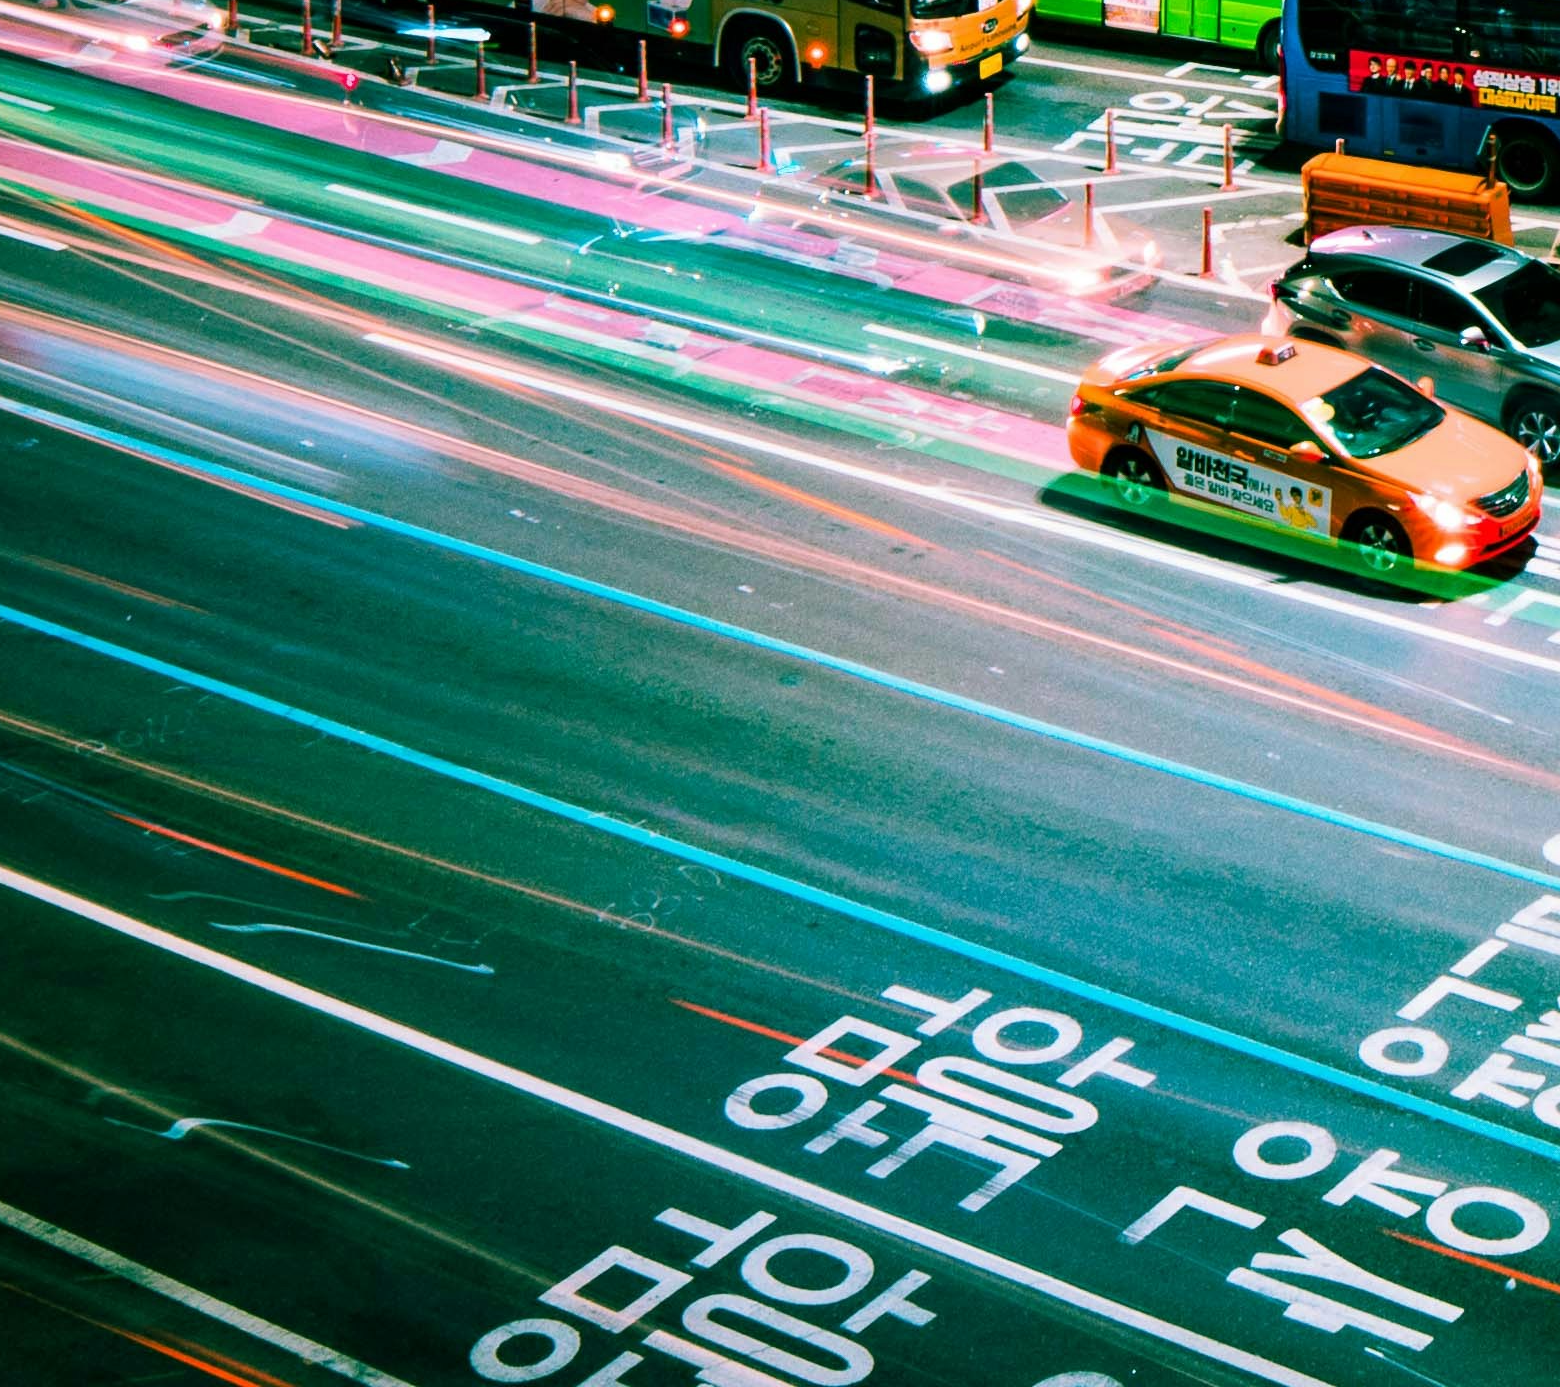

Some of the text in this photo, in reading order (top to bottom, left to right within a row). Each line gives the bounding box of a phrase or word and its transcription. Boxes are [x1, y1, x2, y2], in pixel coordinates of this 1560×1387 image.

[1208, 479, 1230, 500] 알바
[724, 985, 1158, 1212] 후암동
[1121, 1120, 1550, 1352] 용산
